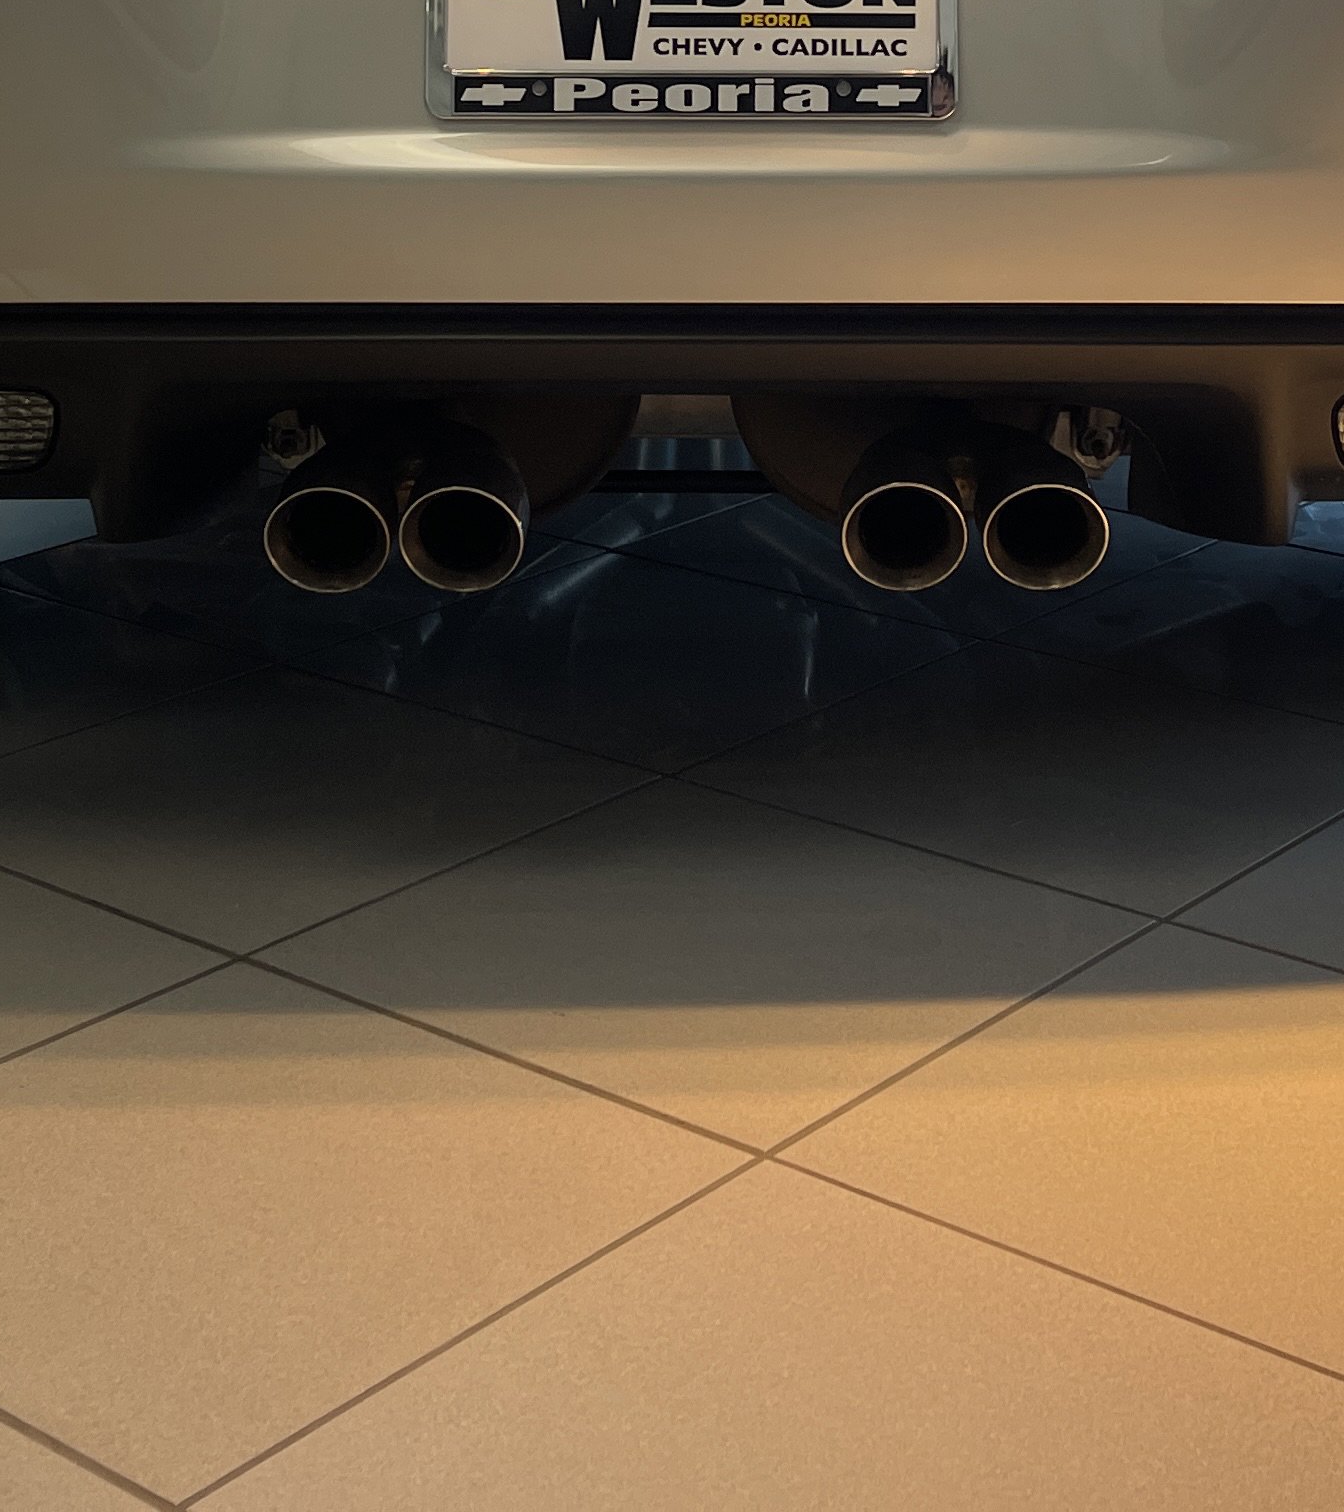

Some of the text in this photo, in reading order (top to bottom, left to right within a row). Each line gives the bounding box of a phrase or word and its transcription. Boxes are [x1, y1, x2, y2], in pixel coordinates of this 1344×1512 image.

[740, 13, 811, 28] PEORIA
[652, 37, 909, 57] CHEVY CADILLAC
[553, 76, 831, 113] Peoria
